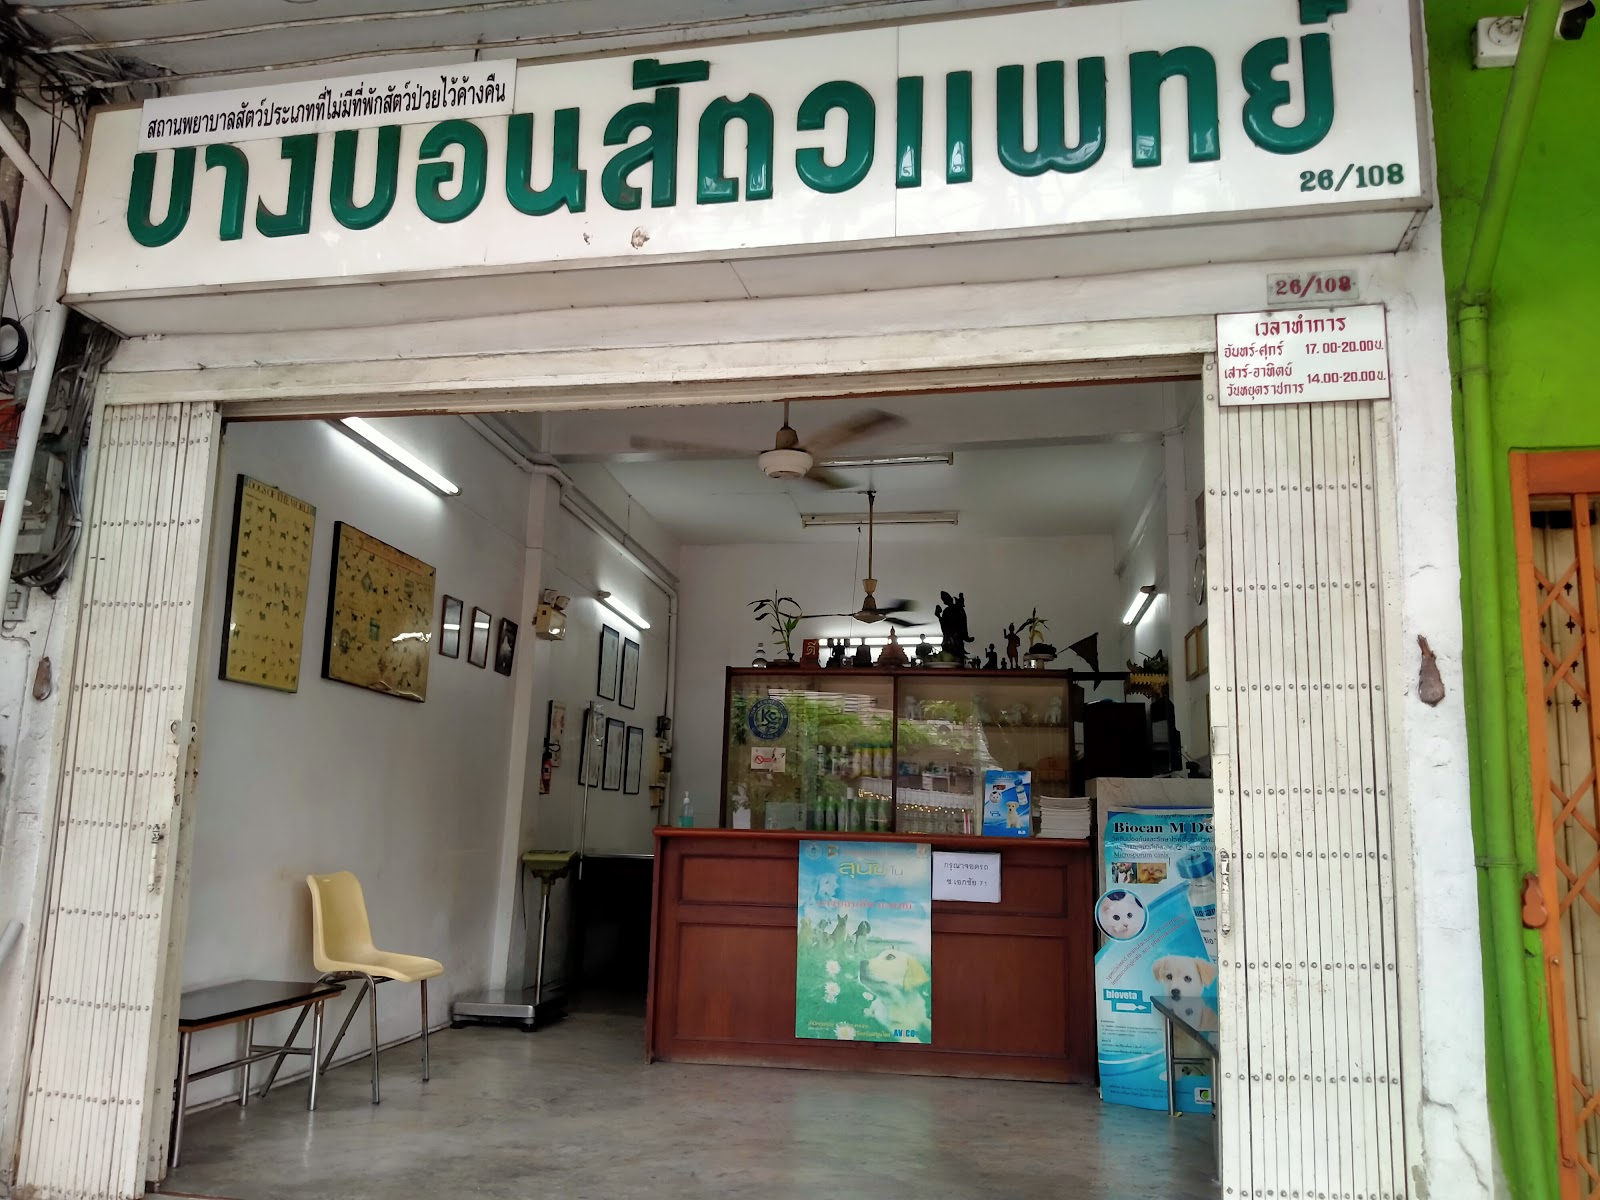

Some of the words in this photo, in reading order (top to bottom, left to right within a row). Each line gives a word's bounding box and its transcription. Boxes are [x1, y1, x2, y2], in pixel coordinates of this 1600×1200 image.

[146, 73, 507, 139] สถานพยาบาลสัตว์ประเภทที่ไม่มีที่พักสัตว์ป่วยไว้ค้างคืน
[1299, 162, 1405, 193] 26/108
[1275, 274, 1352, 298] 26/108
[1255, 313, 1347, 337] เวลาทำการ
[1226, 381, 1305, 401] วันหยุดราชการ
[1113, 822, 1163, 833] Biocan
[1169, 822, 1186, 833] M
[943, 862, 989, 871] กรุณาจอดรถ
[953, 877, 977, 886] เอกชัย
[1105, 989, 1138, 1000] bioveta
